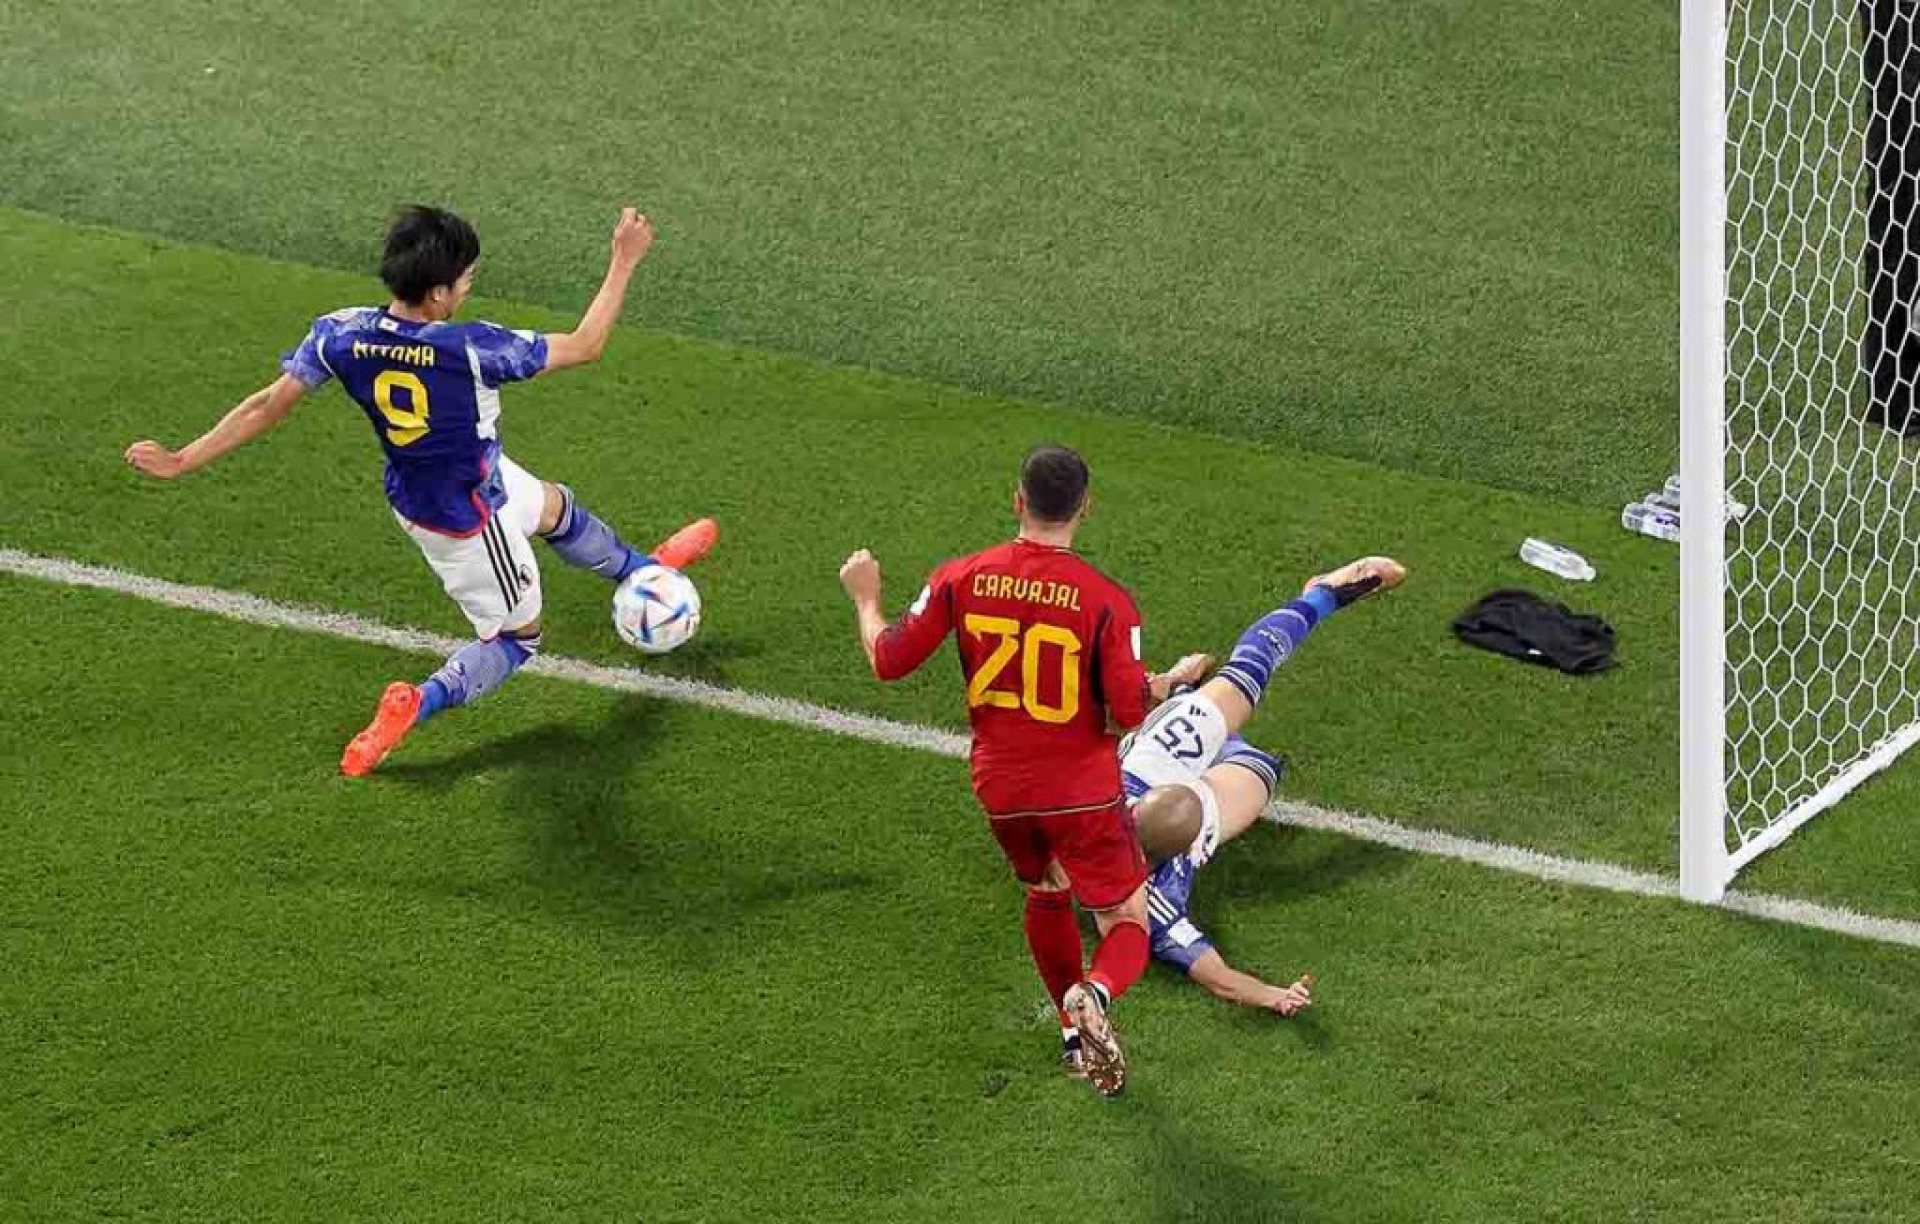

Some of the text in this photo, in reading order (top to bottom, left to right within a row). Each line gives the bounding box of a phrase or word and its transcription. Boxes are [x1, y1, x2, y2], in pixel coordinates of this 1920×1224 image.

[373, 369, 431, 447] 9
[973, 573, 1081, 612] CARVAJAL
[964, 612, 1083, 724] 20
[1153, 716, 1204, 759] 25
